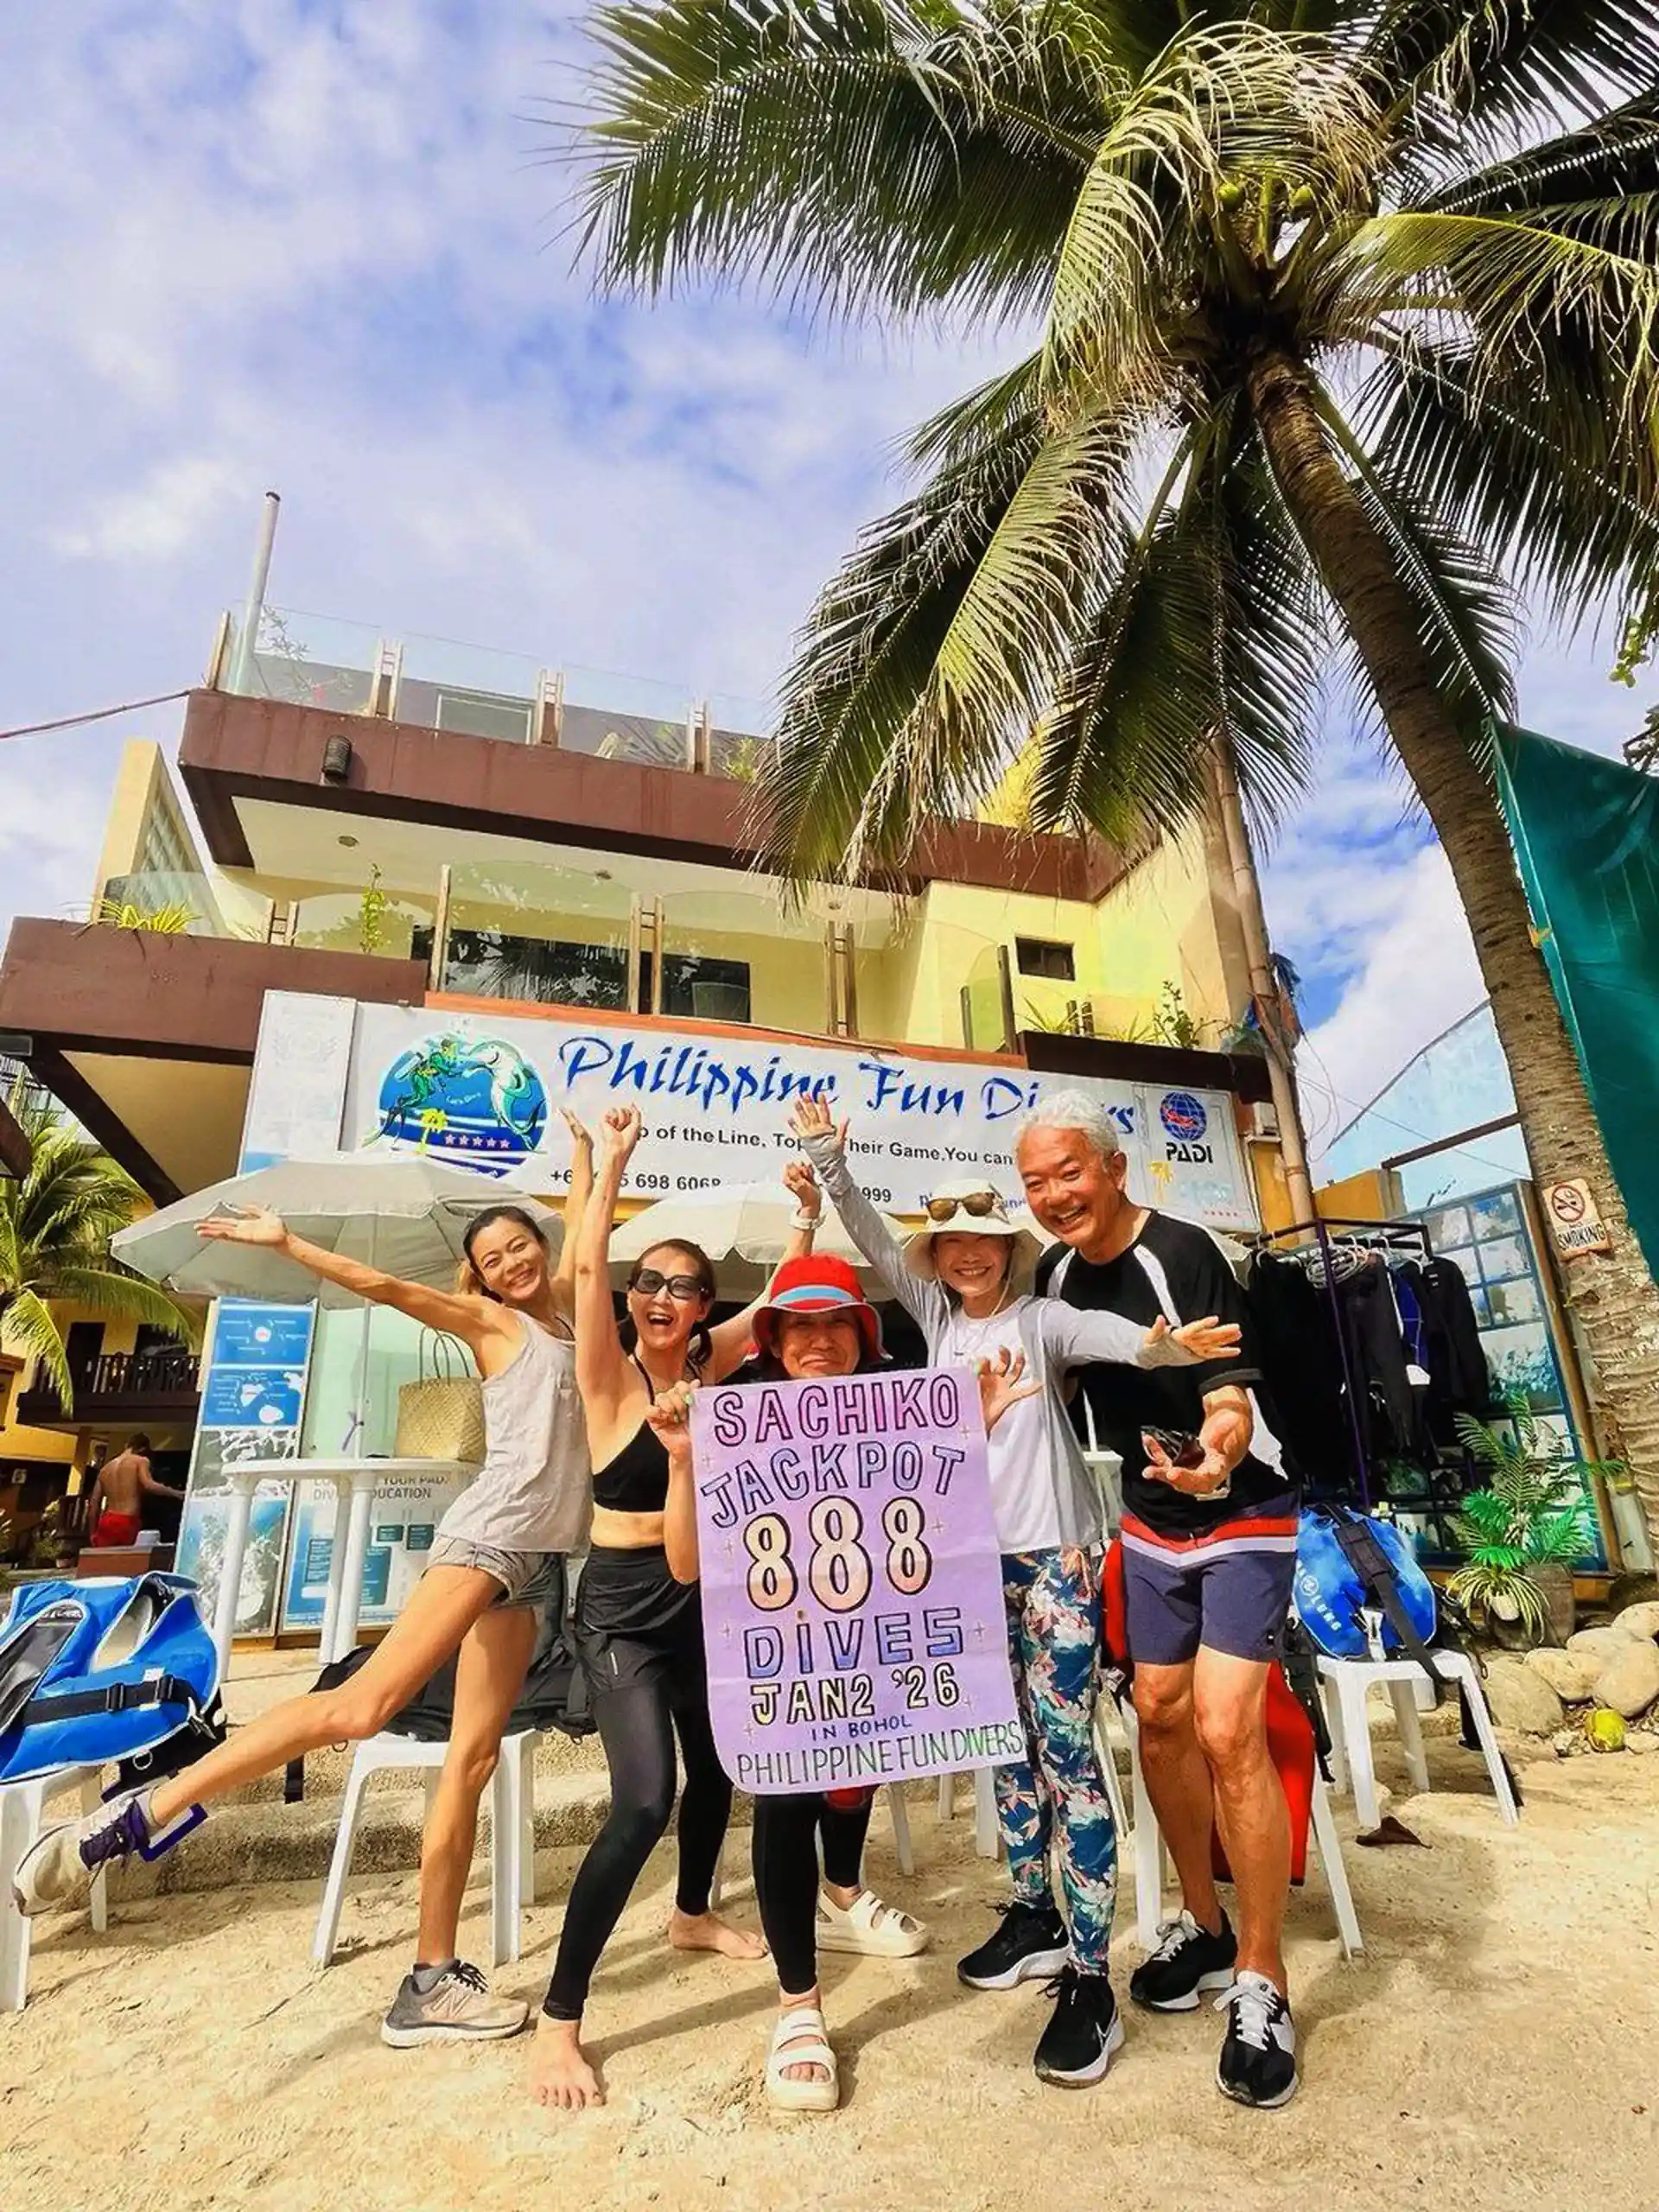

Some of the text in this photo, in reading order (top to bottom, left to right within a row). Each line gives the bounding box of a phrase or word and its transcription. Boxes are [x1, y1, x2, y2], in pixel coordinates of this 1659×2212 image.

[559, 1037, 1134, 1135] Philippine Fun Dis
[657, 1125, 676, 1139] of
[683, 1127, 714, 1142] the
[849, 1138, 883, 1154] heir
[983, 1153, 1013, 1165] can
[1166, 1142, 1213, 1164] PADI
[635, 1173, 670, 1189] 698
[713, 1373, 959, 1447] SACHIKO
[372, 1487, 432, 1499] UCATION
[700, 1440, 965, 1529] JACKPOT
[743, 1495, 933, 1614] 888
[812, 1714, 912, 1741] IN BOHOL
